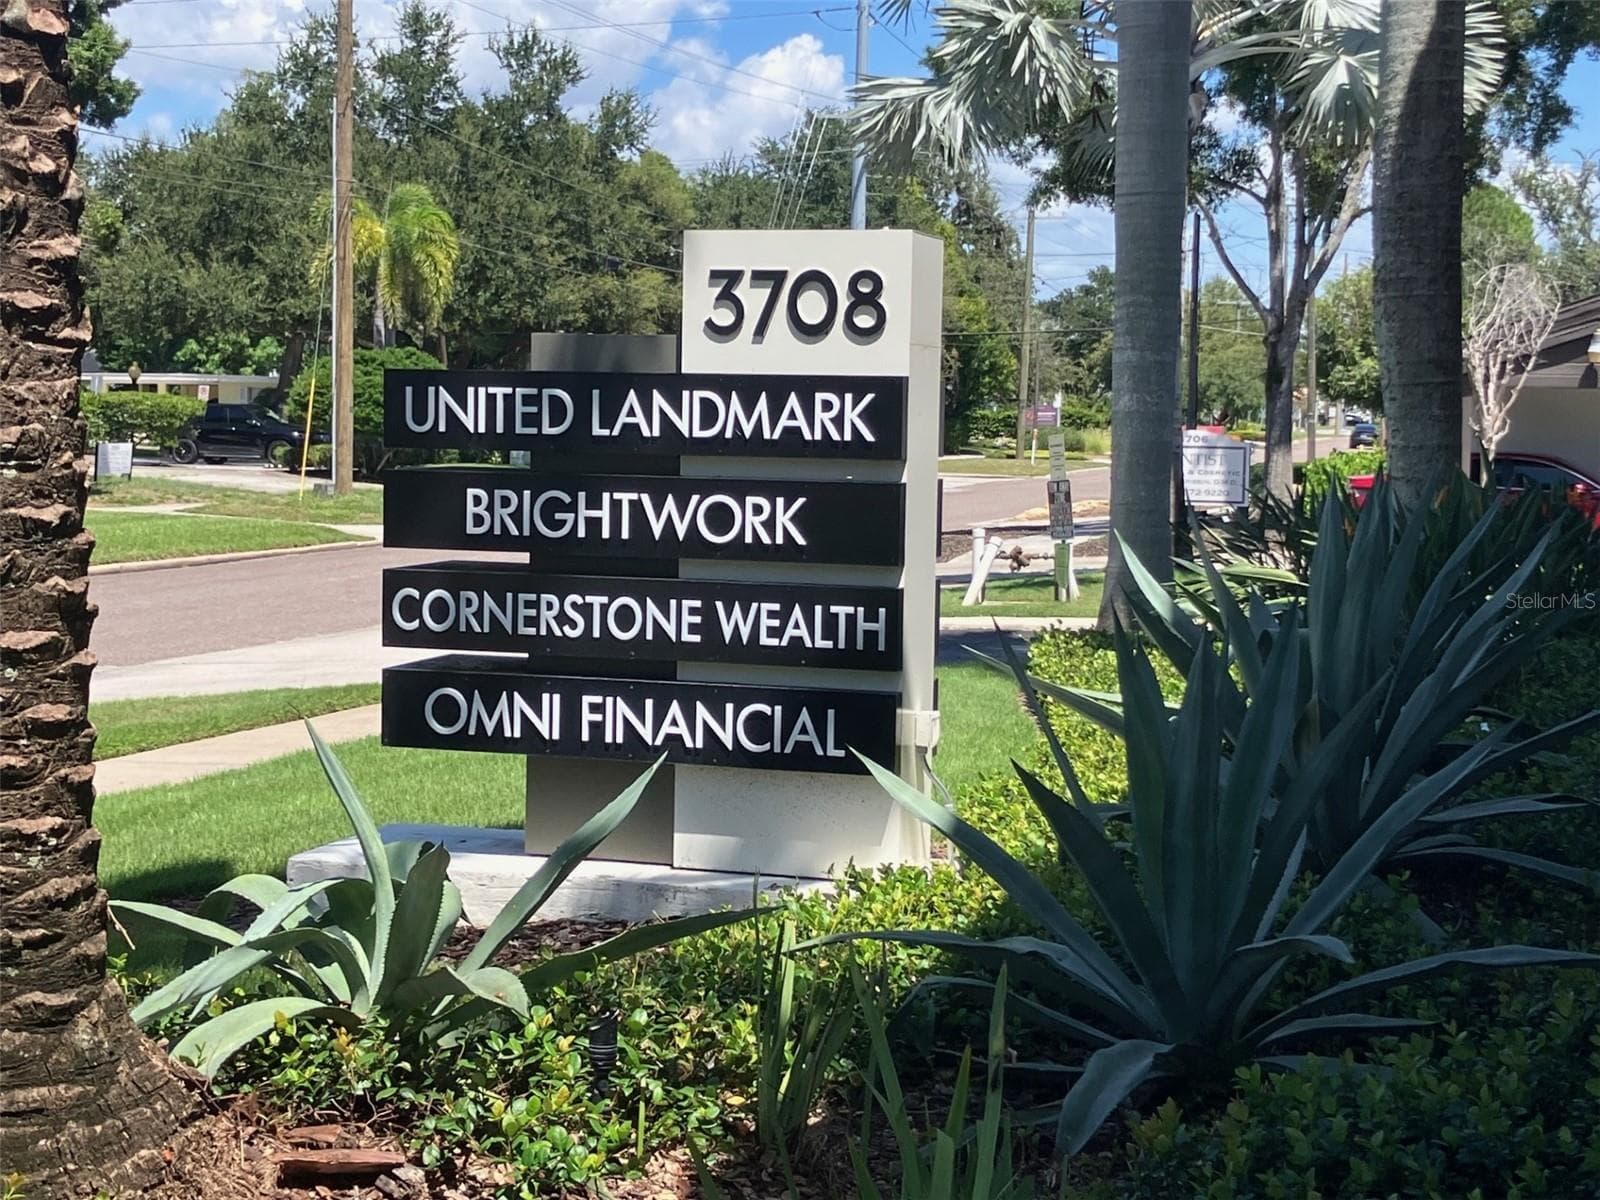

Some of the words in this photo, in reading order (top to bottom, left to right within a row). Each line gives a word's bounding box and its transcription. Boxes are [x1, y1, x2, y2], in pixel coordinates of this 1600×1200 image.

[703, 268, 888, 341] 3708
[404, 385, 574, 436] UNITED
[591, 388, 877, 443] LANDMARK
[465, 487, 807, 547] BRIGHTWORK
[391, 587, 702, 642] CORNERSTONE
[714, 600, 887, 652] WEALTH
[423, 686, 561, 741] OMNI
[580, 694, 847, 757] FINANCIAL
